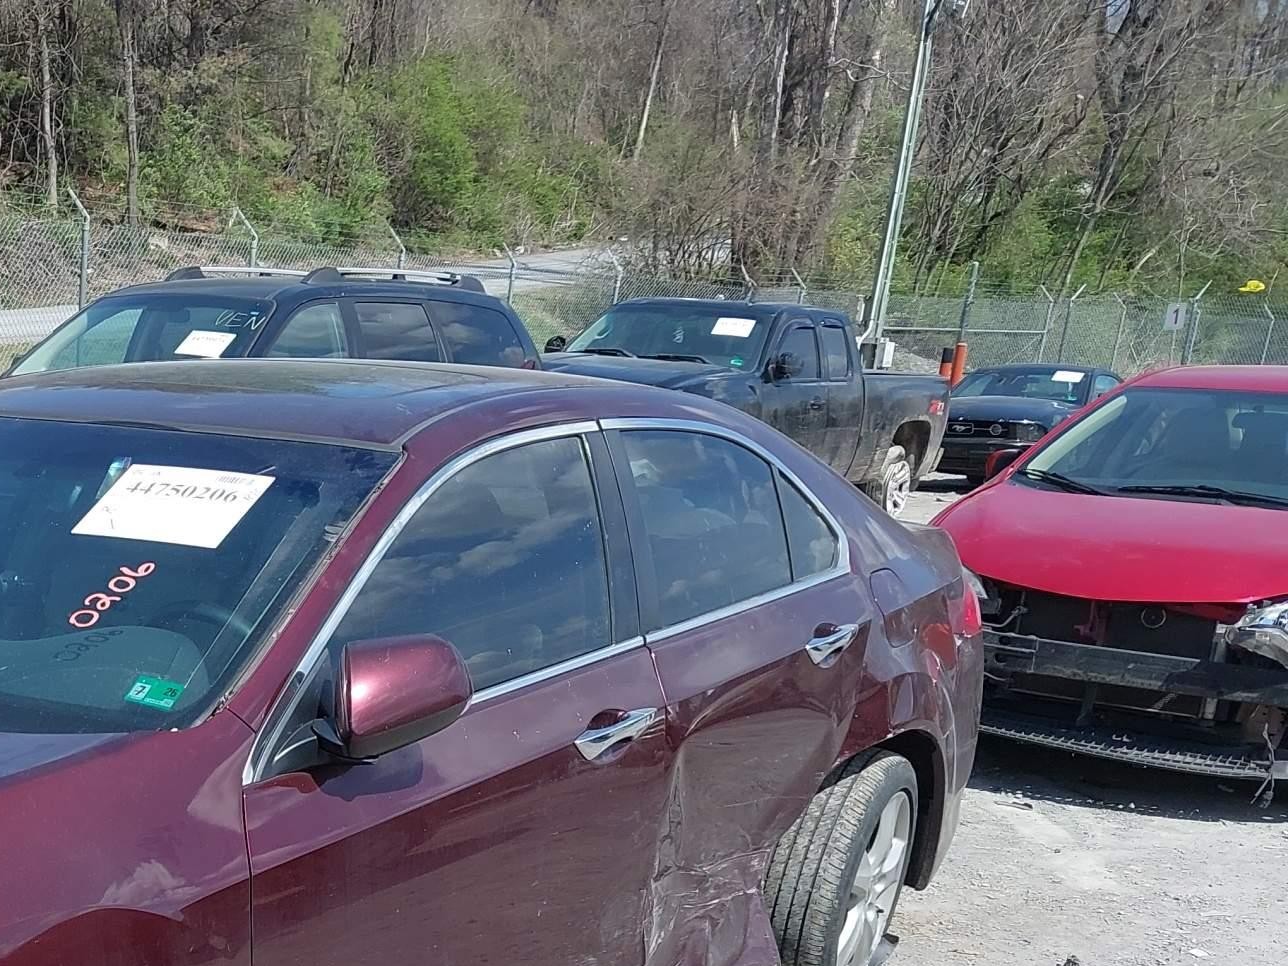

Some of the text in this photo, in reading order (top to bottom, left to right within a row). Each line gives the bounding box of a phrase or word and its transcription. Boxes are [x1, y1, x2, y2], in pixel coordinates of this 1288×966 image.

[215, 309, 266, 330] VEN
[1173, 308, 1180, 325] 1
[126, 481, 238, 503] 44750206
[69, 562, 156, 628] 0206
[135, 685, 147, 696] 7
